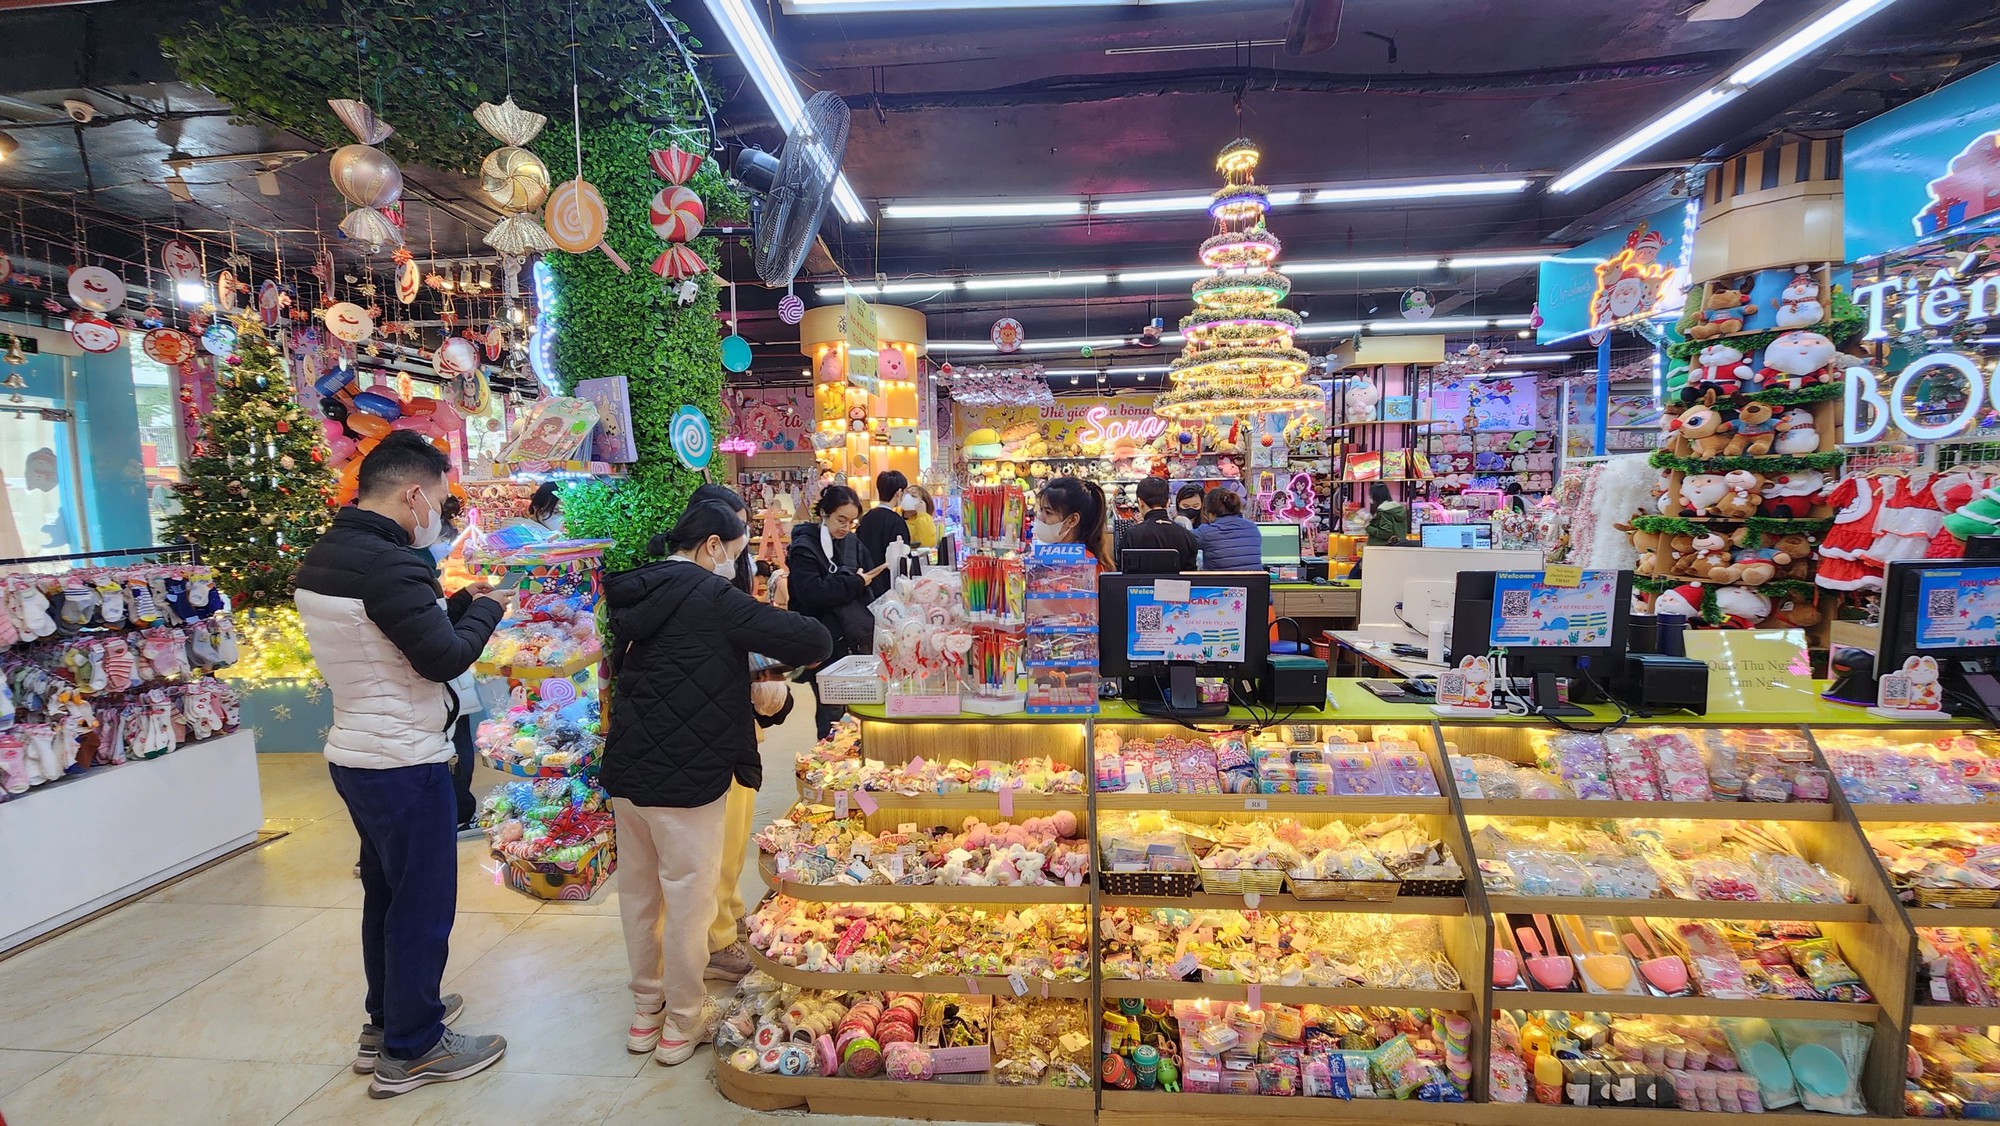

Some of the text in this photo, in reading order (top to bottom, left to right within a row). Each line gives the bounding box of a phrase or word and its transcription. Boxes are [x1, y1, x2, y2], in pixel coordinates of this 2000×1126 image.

[1852, 252, 2000, 341] Tiến
[1844, 352, 2000, 444] BOO
[1040, 405, 1064, 418] Thế
[1120, 404, 1150, 419] bông
[1080, 406, 1168, 444] Sora
[1039, 546, 1083, 556] HALLS
[1212, 598, 1218, 606] 6
[1741, 660, 1765, 671] Thu
